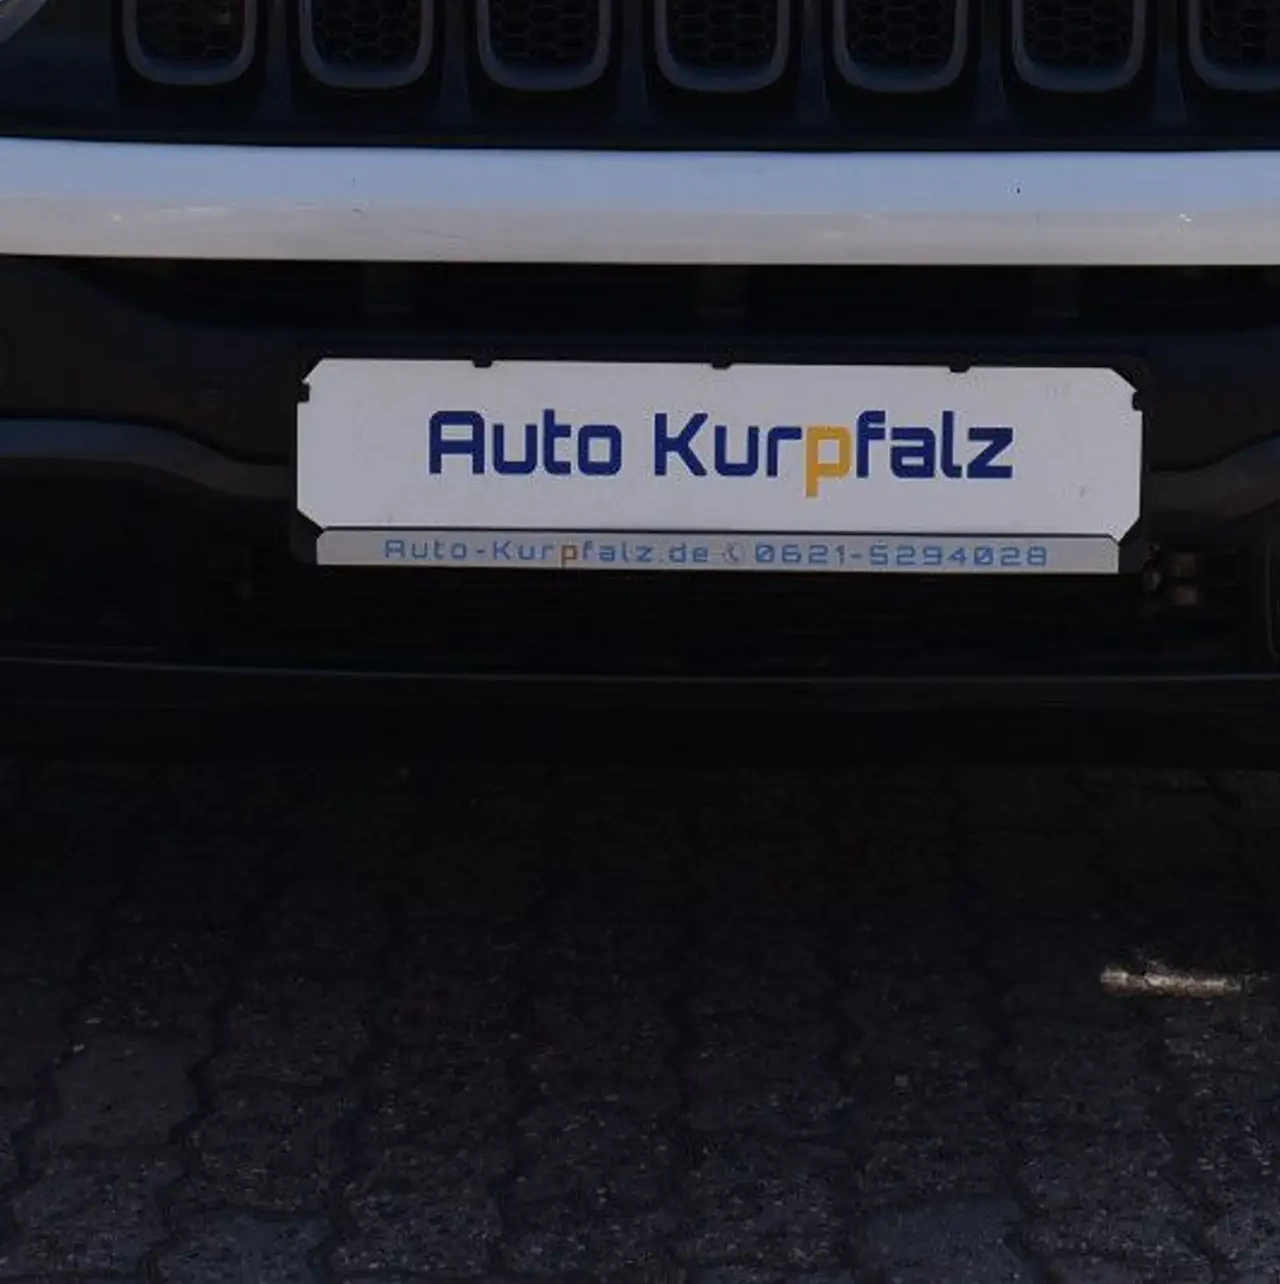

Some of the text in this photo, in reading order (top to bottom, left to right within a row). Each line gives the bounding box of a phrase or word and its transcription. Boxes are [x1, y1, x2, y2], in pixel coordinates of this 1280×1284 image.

[429, 409, 1014, 498] Auto Kurpfalz
[384, 539, 1048, 567] Auto-Kurpfalz.de 0621-5294028
